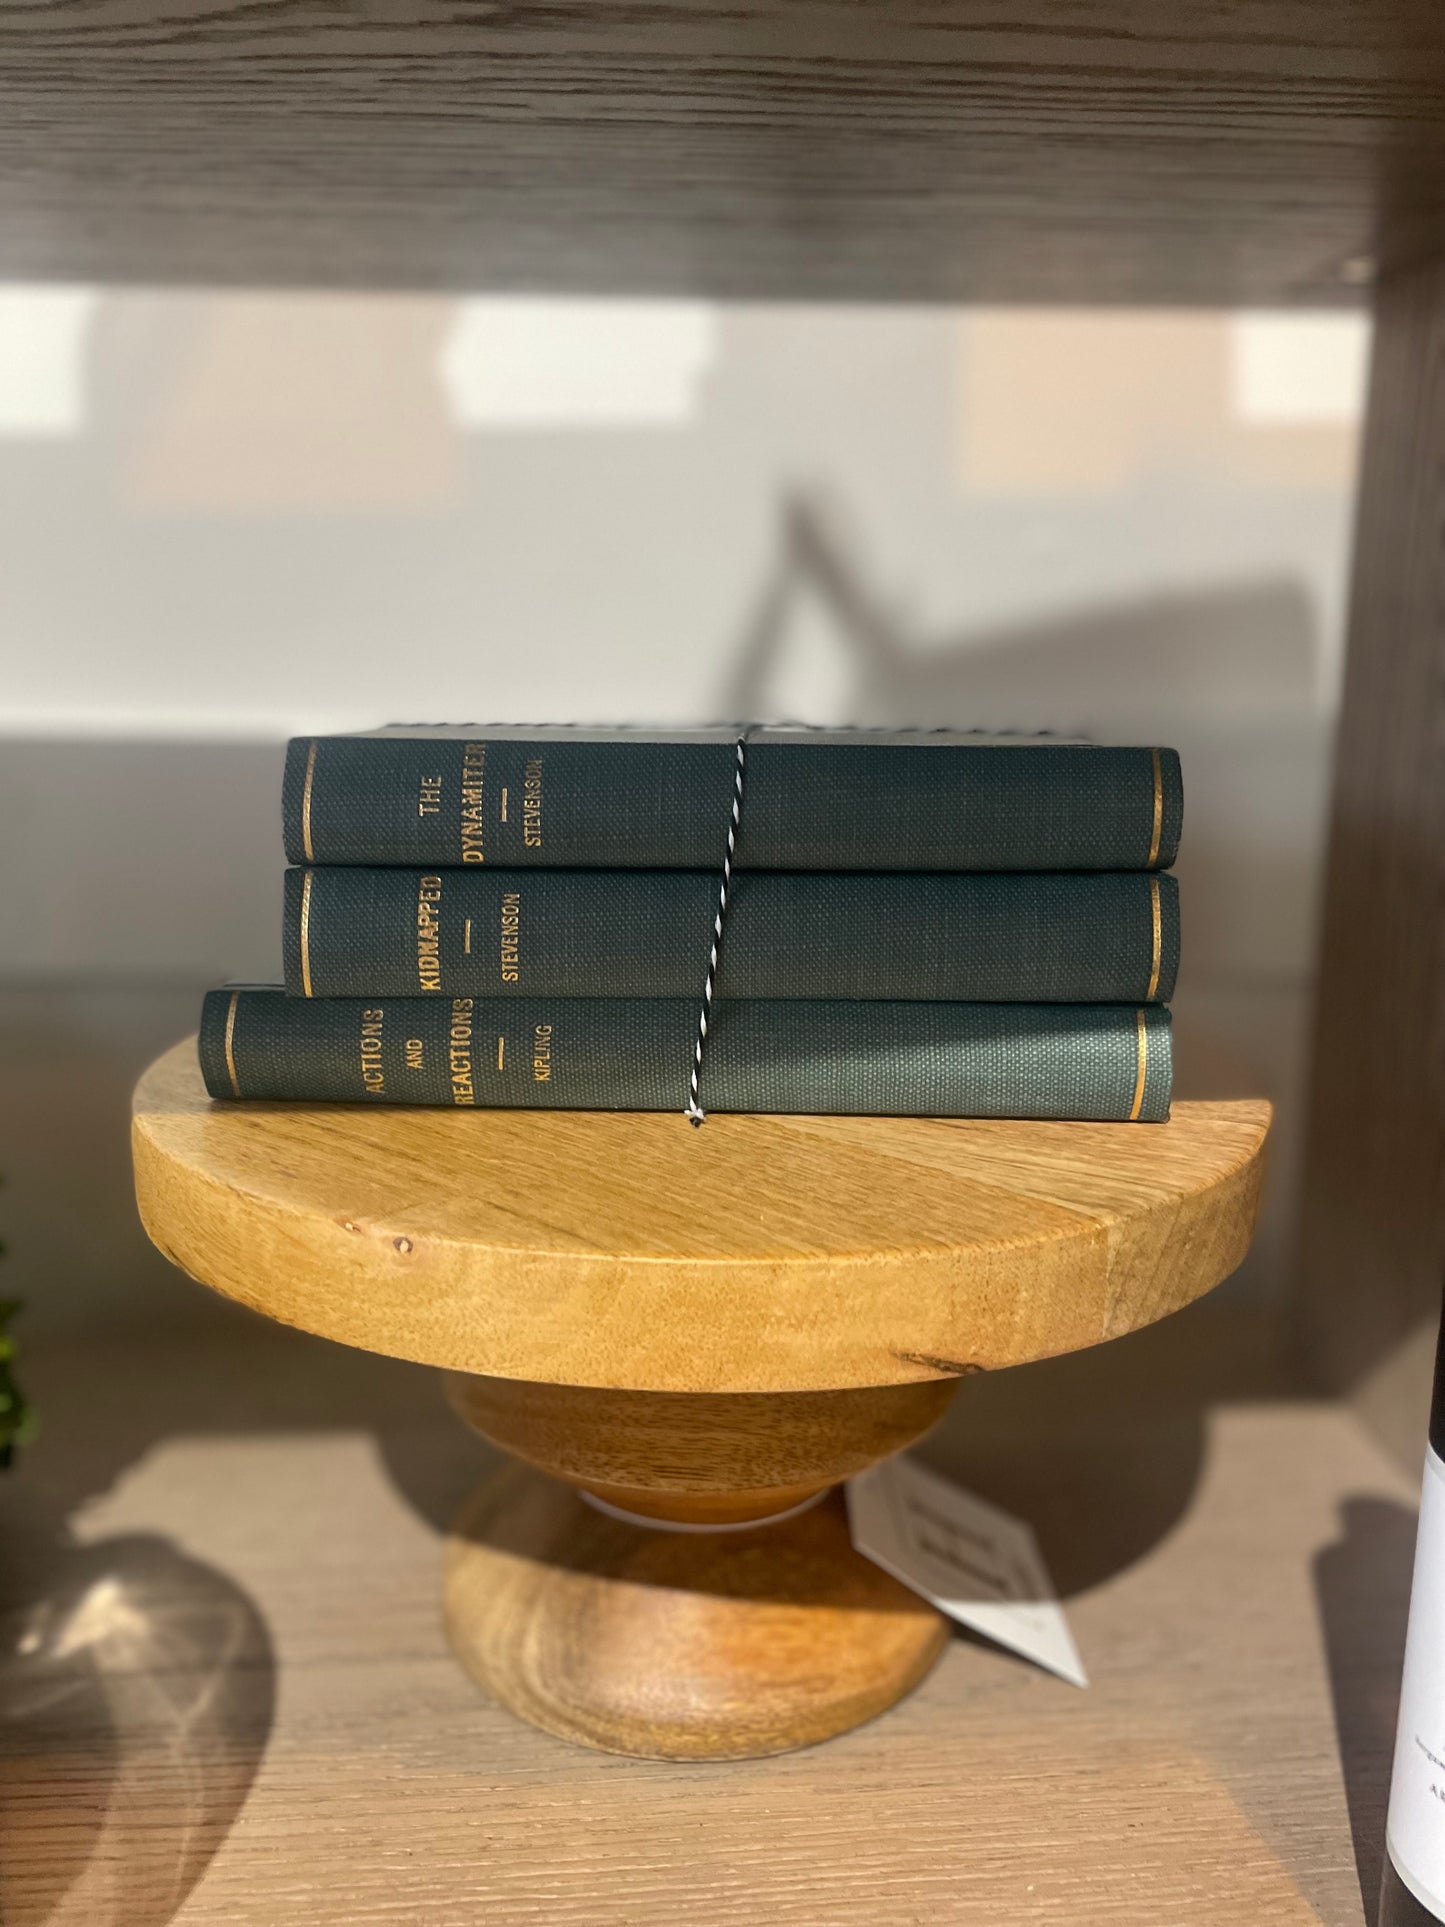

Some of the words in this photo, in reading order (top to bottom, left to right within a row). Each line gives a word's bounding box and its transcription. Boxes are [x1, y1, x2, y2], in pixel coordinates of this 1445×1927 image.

[419, 776, 442, 816] THE
[462, 743, 486, 863] DYNAMITER
[524, 758, 543, 847] STEVENSON
[419, 876, 442, 991] KIDNAPPED
[502, 892, 520, 982] STEVENSON
[362, 1009, 384, 1094] ACTIONS
[406, 1038, 423, 1069] AND
[450, 998, 474, 1105] REACTIONS
[534, 1024, 552, 1082] KIPLING
